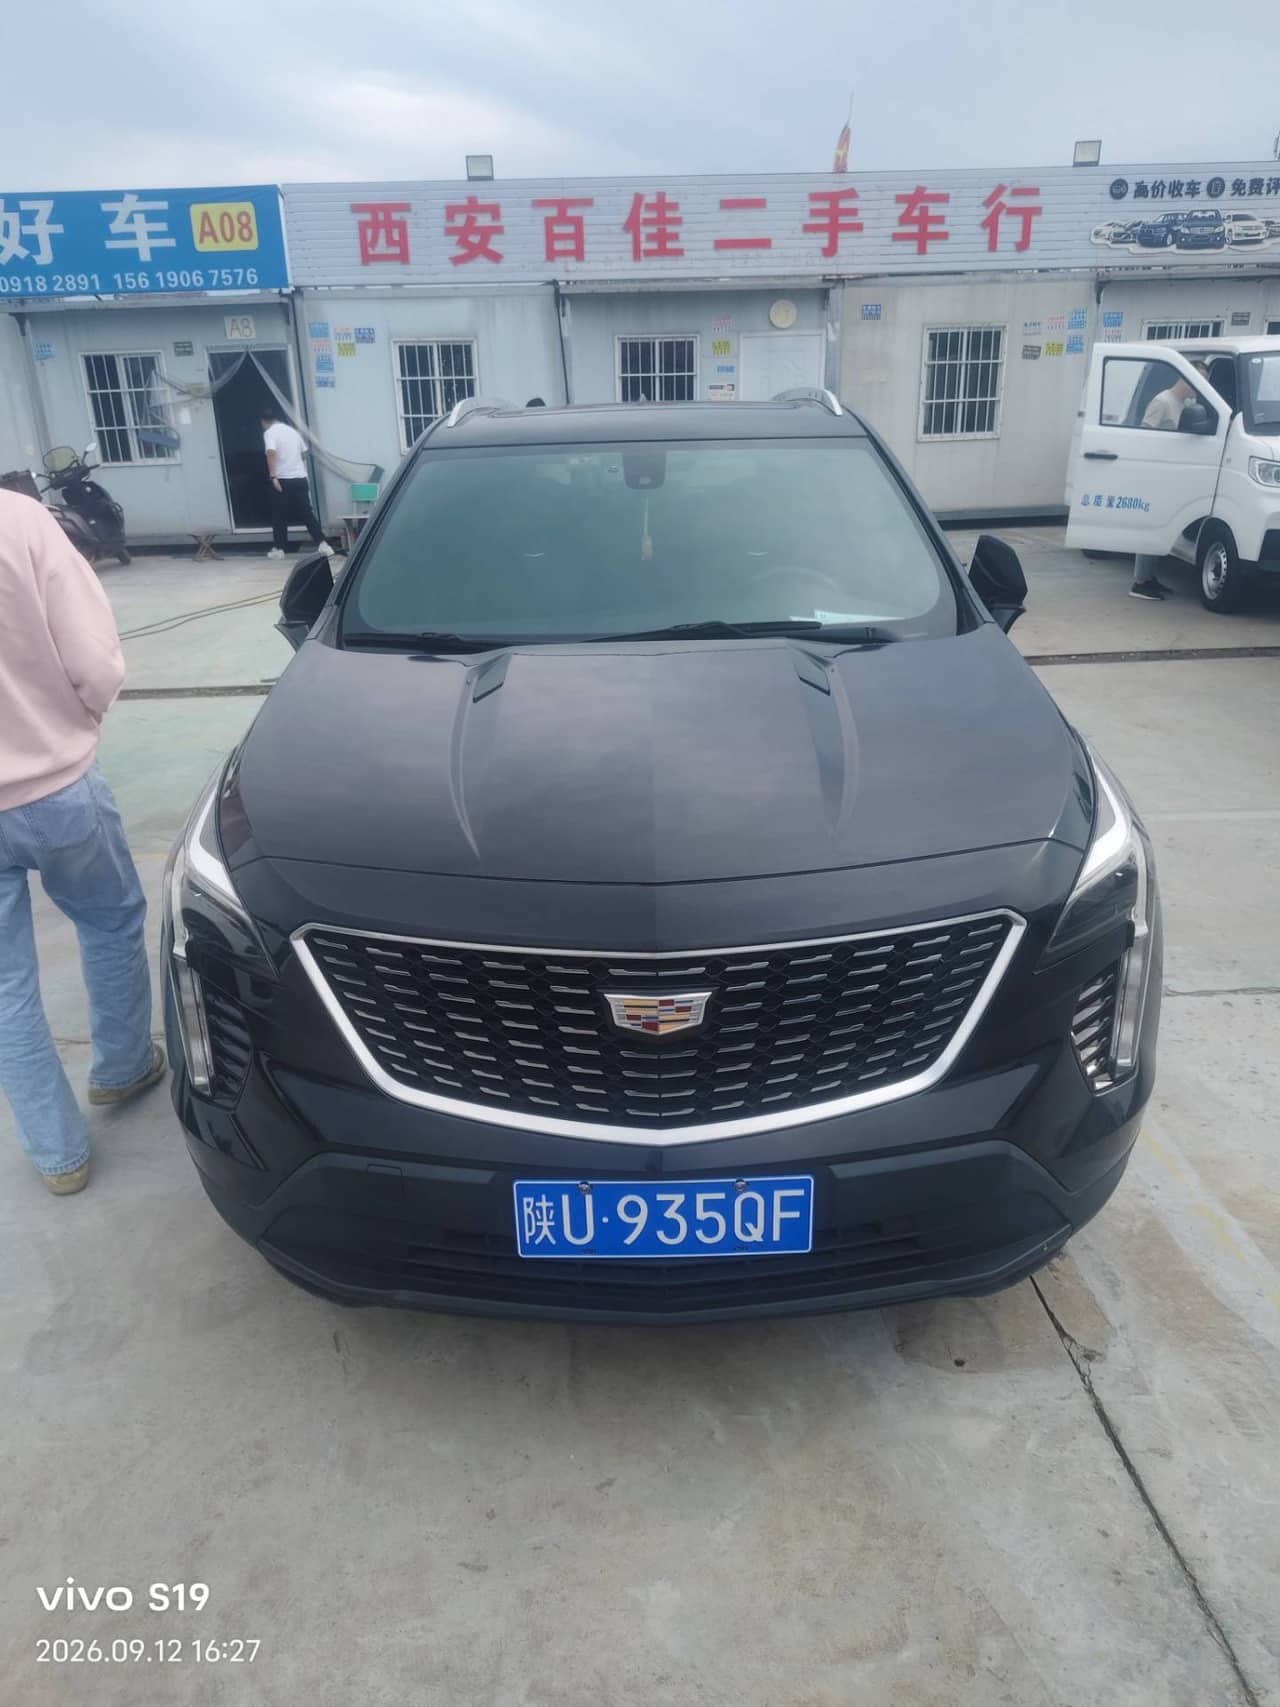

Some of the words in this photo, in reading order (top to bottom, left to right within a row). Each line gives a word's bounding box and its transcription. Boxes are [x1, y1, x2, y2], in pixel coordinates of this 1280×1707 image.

[1133, 180, 1201, 199] 高价收车
[0, 193, 176, 265] 好车
[198, 209, 254, 245] A08
[351, 183, 1043, 266] 西安百佳二手车行
[0, 275, 47, 292] 0918
[52, 273, 100, 291] 2891
[113, 271, 150, 289] 156
[155, 270, 204, 288] 1906
[208, 268, 258, 286] 7576
[229, 317, 252, 338] A8
[523, 1189, 805, 1245] 陕U·935QF
